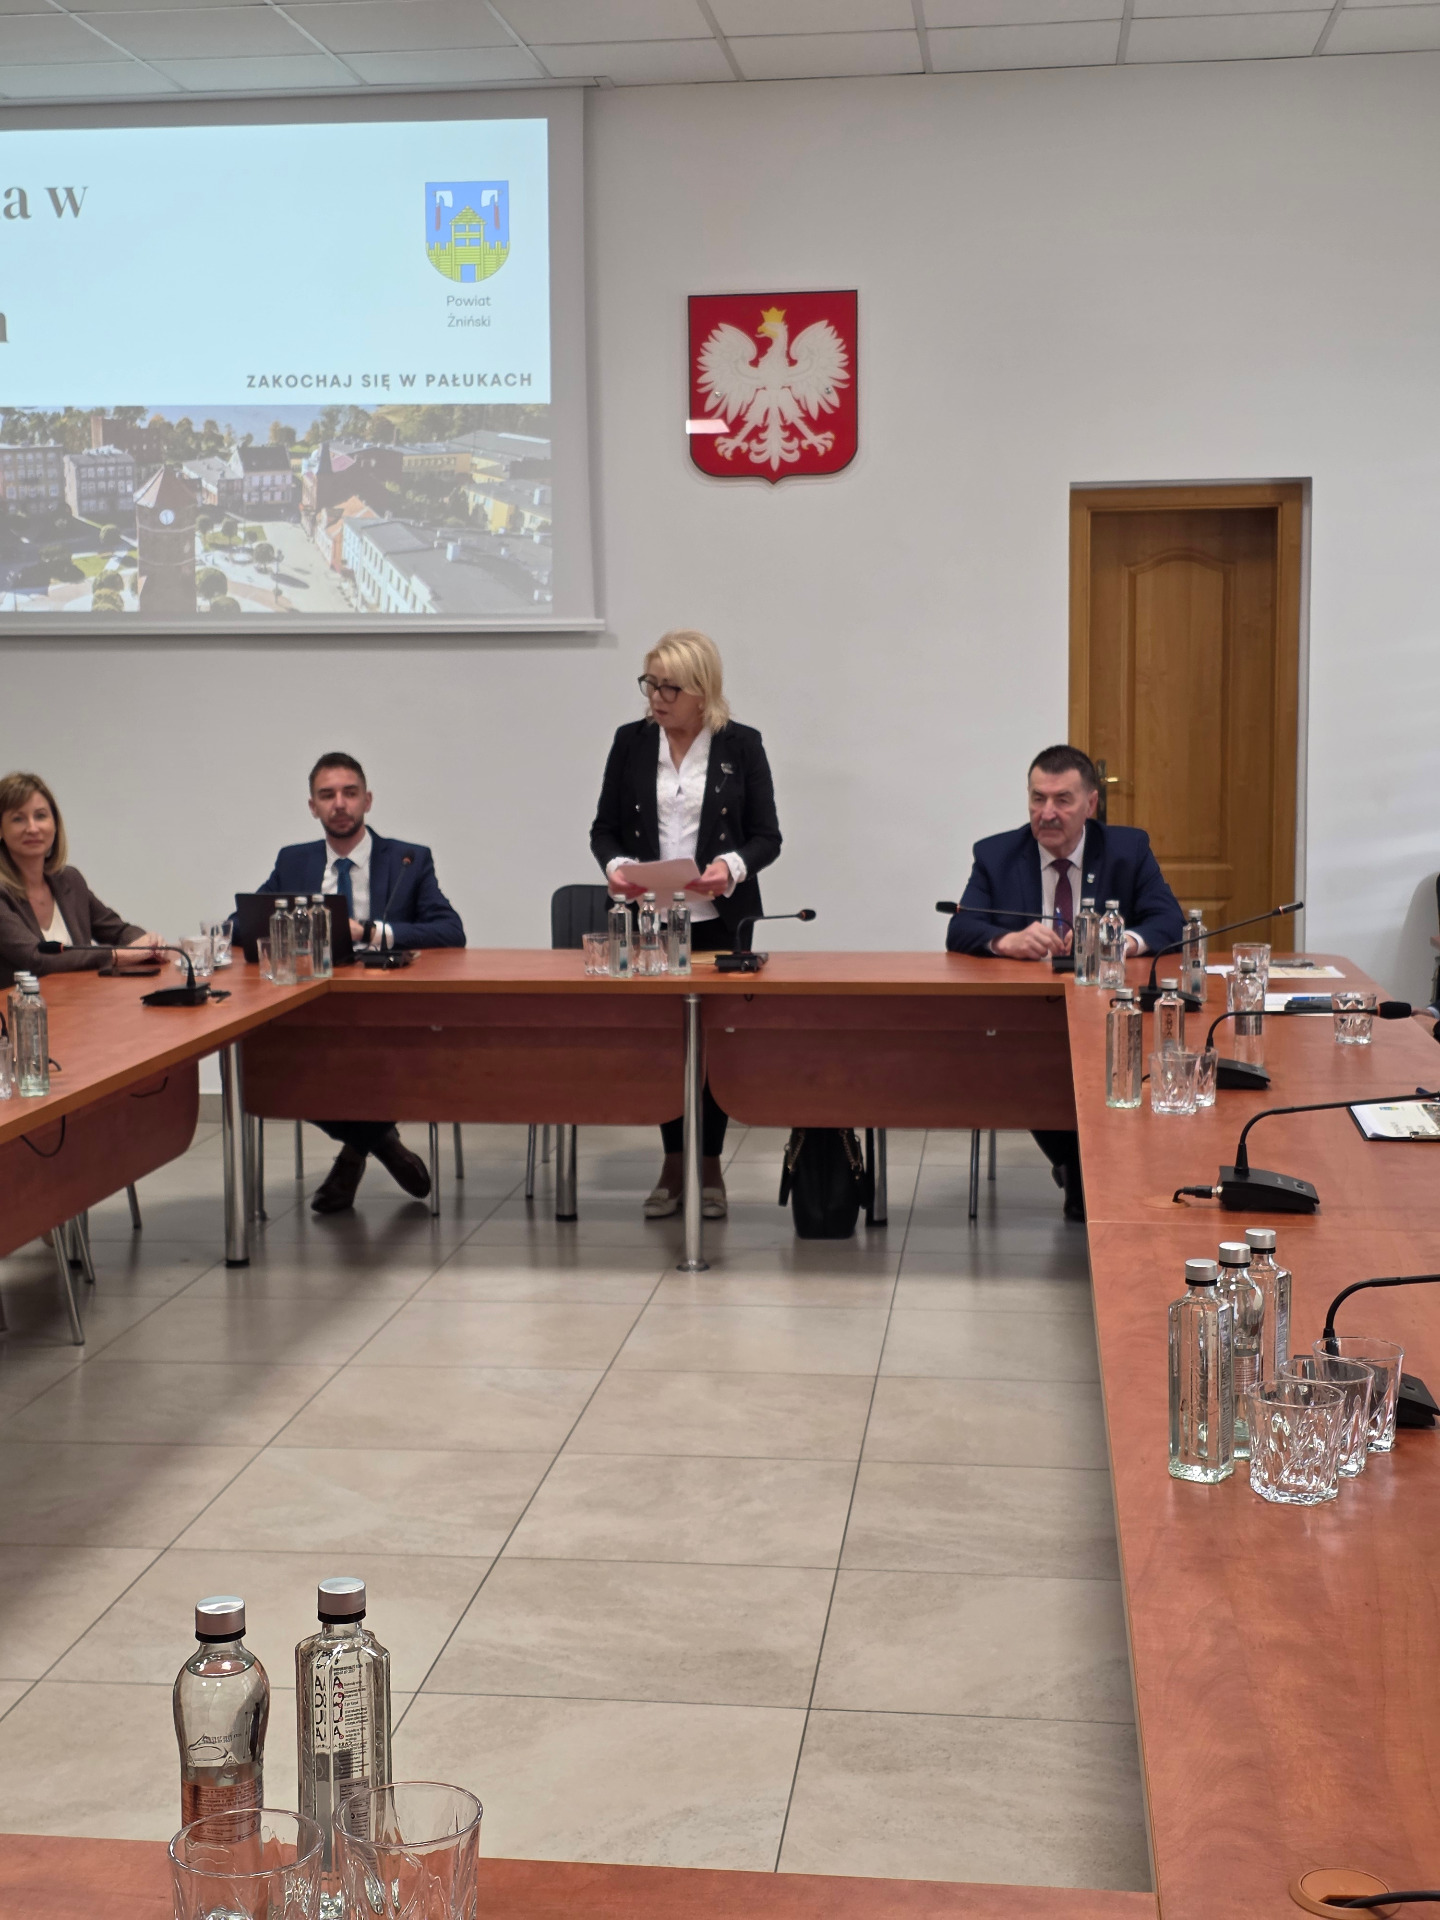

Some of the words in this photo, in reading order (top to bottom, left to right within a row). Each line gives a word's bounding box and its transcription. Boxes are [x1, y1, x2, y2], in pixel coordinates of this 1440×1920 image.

[0, 186, 32, 220] a
[44, 186, 89, 219] w
[446, 295, 492, 307] Powiat
[447, 313, 491, 328] Żniński
[246, 374, 353, 389] ZAKOCHAJ
[361, 374, 390, 391] SIĘ
[399, 374, 416, 387] W
[425, 372, 532, 387] PAŁUKACH
